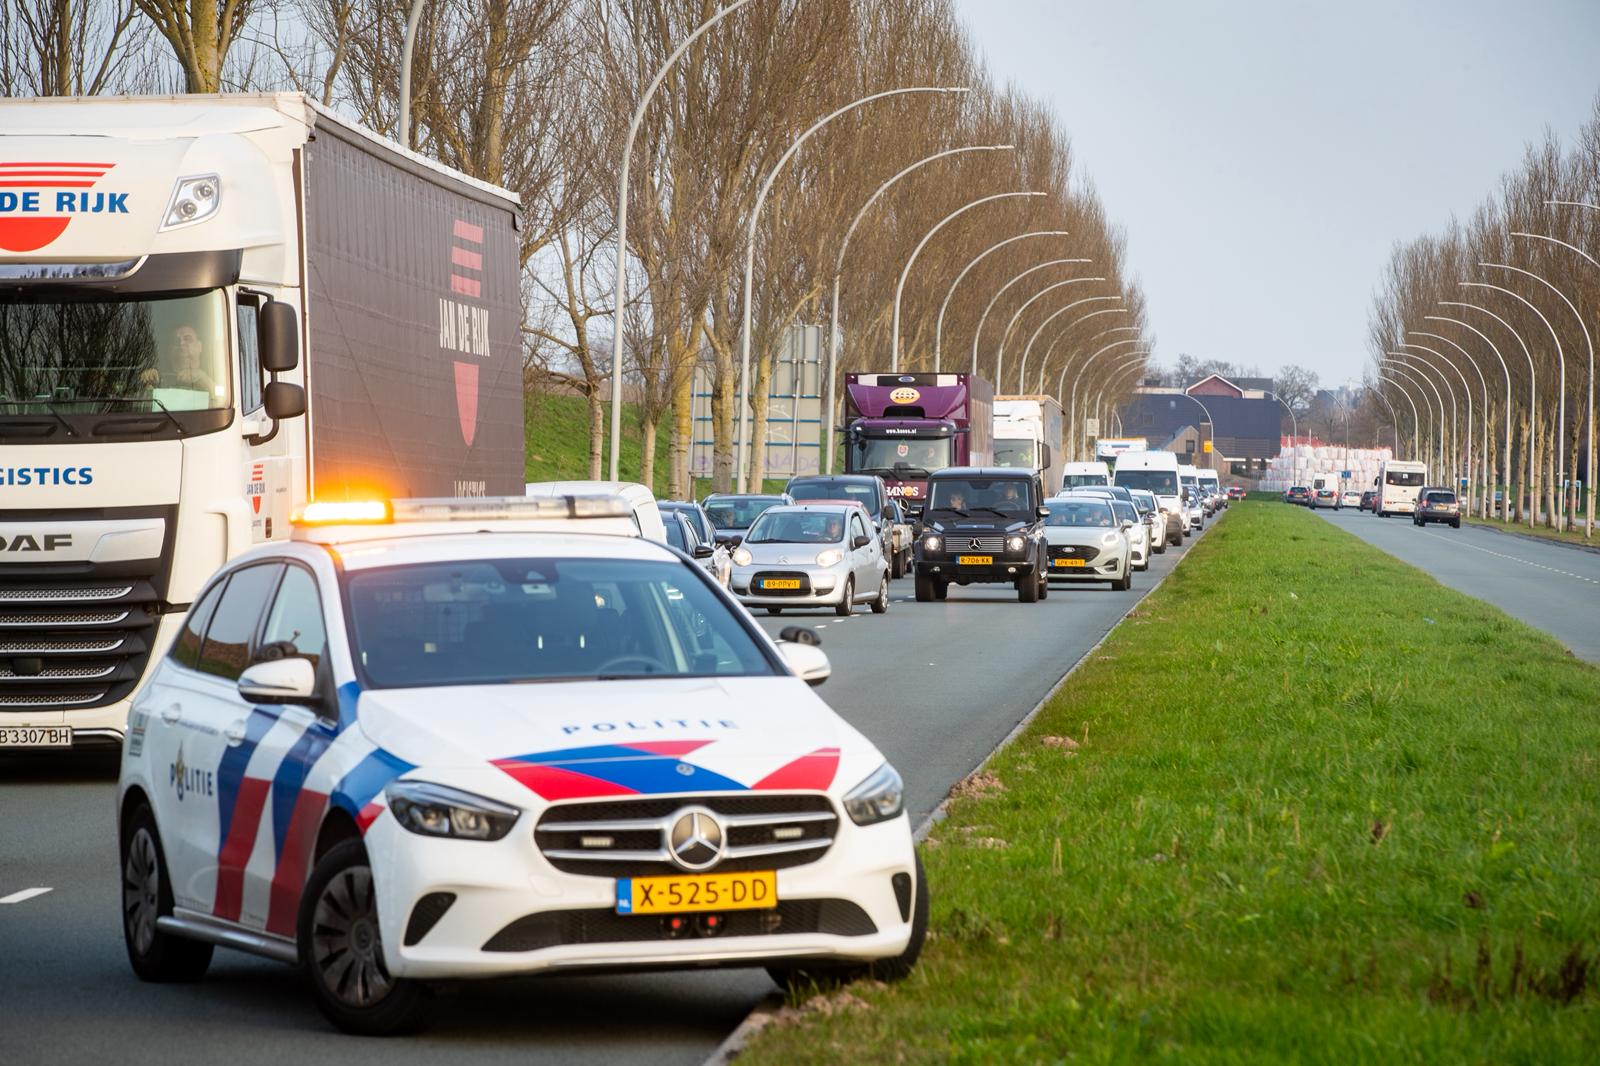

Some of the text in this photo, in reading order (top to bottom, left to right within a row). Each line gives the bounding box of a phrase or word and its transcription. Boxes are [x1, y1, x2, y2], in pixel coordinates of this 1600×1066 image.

[0, 192, 130, 214] DE RIJK
[439, 298, 490, 357] JAN DE RIJK
[0, 467, 93, 485] ISTICS
[0, 533, 72, 552] AF
[561, 719, 739, 735] POLITIE
[639, 878, 768, 907] X-525-DD
